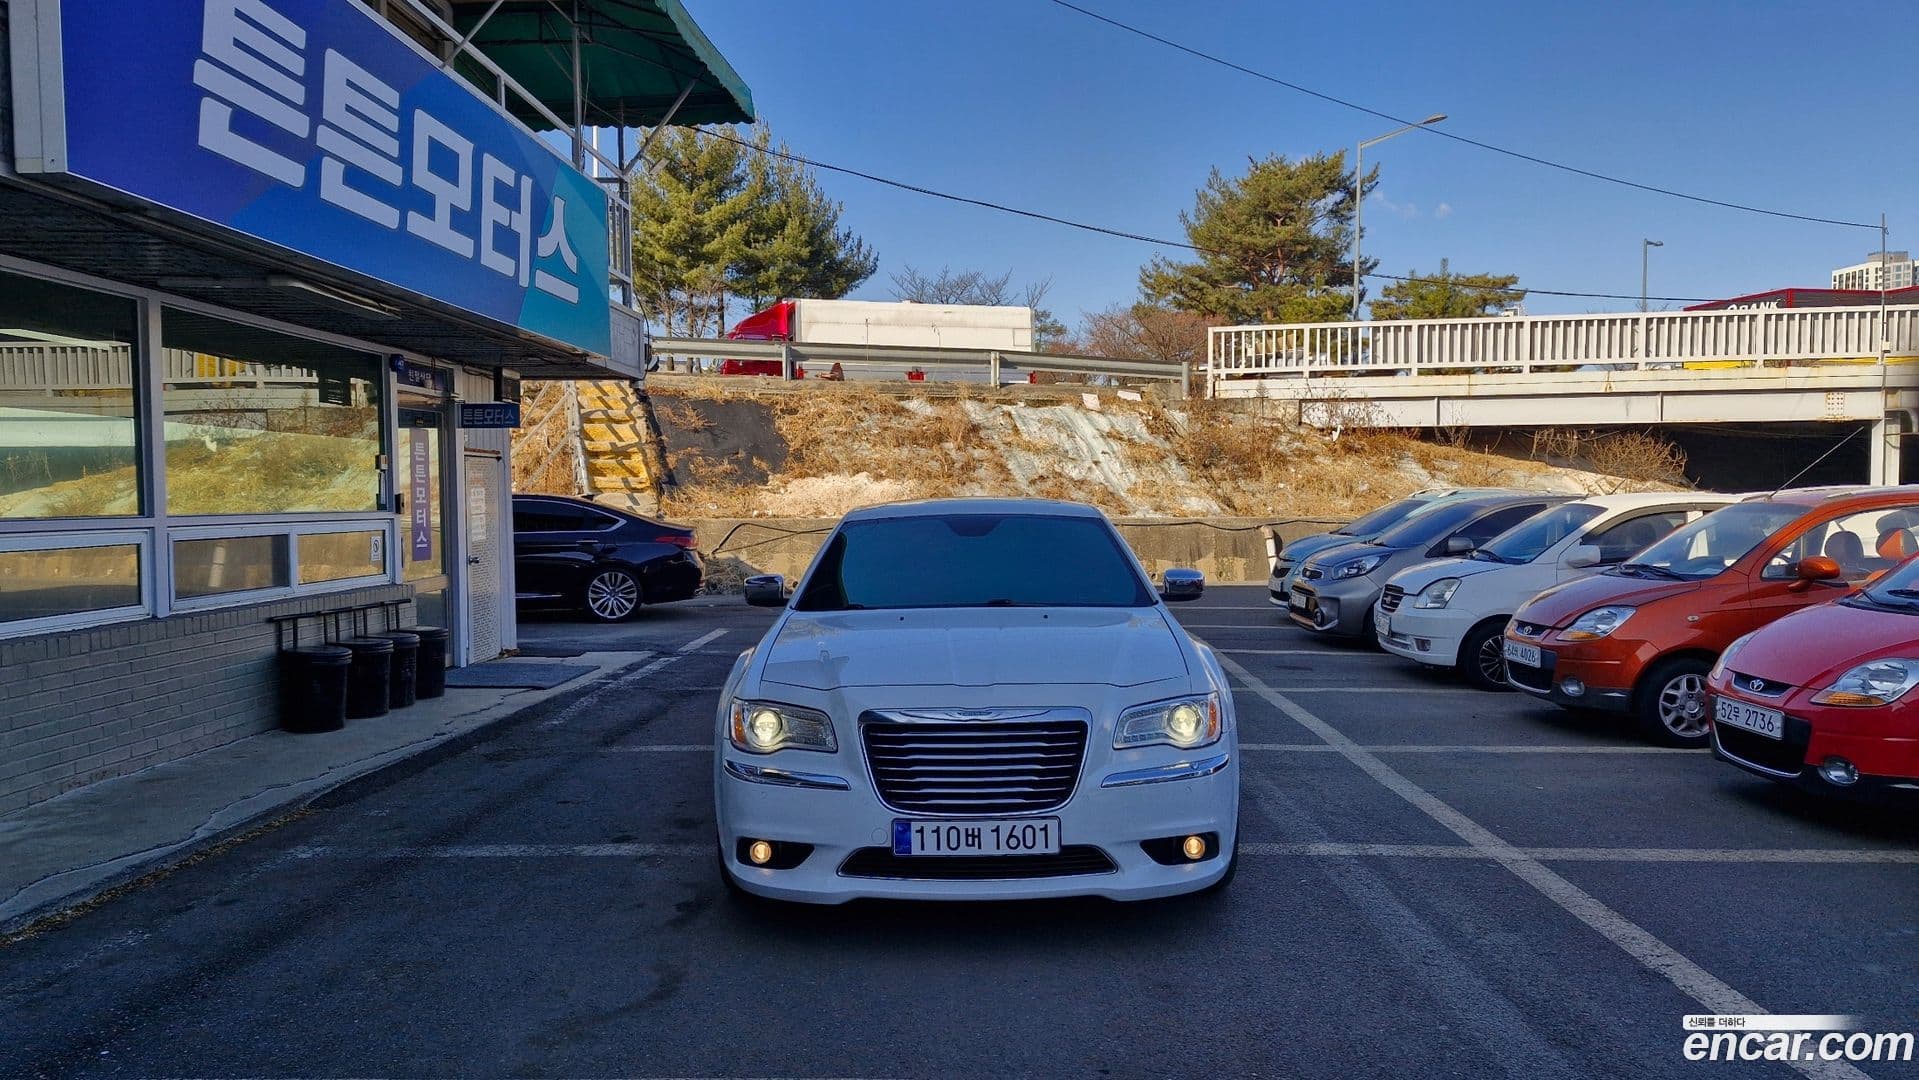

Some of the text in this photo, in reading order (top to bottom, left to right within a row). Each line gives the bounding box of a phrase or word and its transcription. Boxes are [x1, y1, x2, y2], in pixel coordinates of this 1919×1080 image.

[193, 0, 579, 304] 튼튼모터스
[463, 408, 515, 425] 튼튼모터스
[414, 442, 428, 548] 튼튼모터스
[1721, 701, 1775, 733] 52무 2736
[915, 824, 1050, 851] 110버 1601
